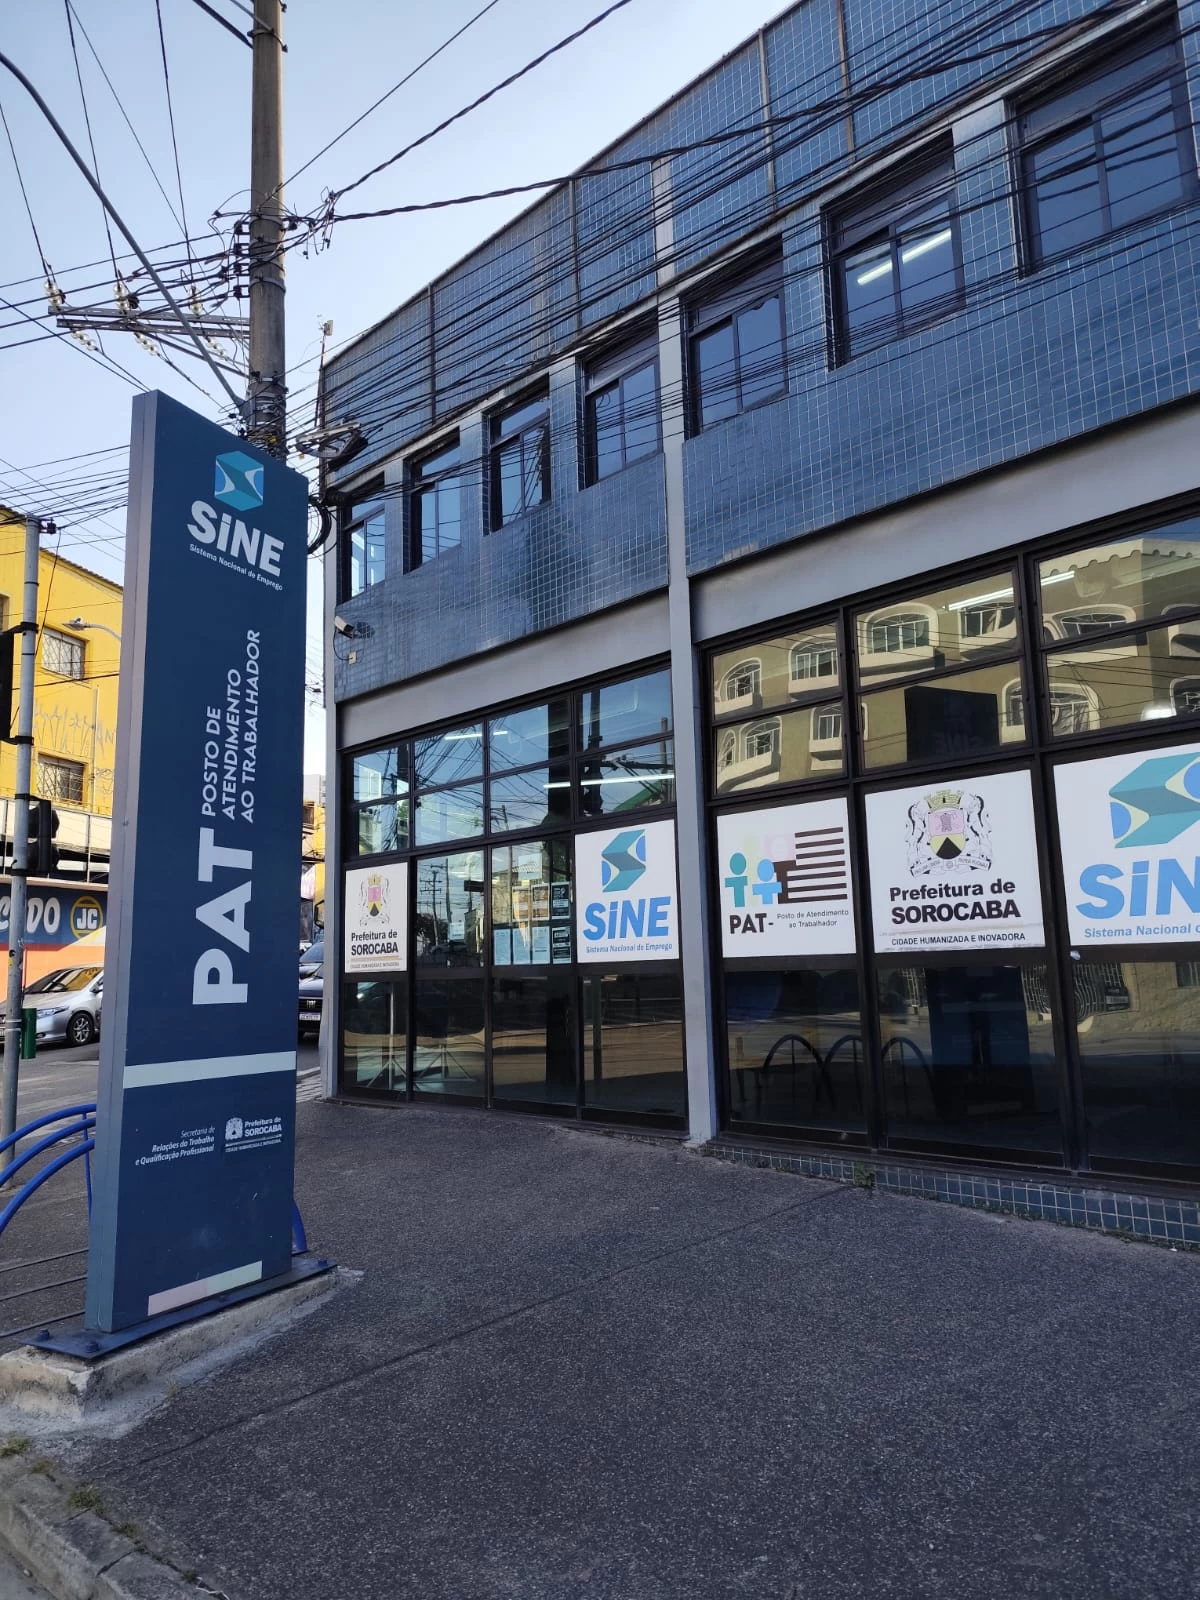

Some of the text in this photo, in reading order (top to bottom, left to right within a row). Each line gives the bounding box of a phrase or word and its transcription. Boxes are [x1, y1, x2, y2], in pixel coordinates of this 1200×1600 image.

[189, 543, 283, 591] Sistema Nacional de Emprego
[241, 629, 260, 823] AO TRABALHADOR
[222, 668, 241, 820] ATENDIMENTO
[202, 706, 221, 817] POSTO DE
[889, 878, 1016, 901] Prefeitura de
[76, 908, 98, 930] JC
[192, 827, 252, 1005] PAT
[806, 909, 849, 919] Atendimento
[891, 899, 1021, 925] SOROCABA
[799, 920, 838, 928] Trabalhador
[1084, 928, 1132, 938] Sistema
[1136, 923, 1191, 936] Nacional
[351, 929, 398, 942] Prefeitura de
[892, 932, 1026, 946] CIDADE HUMANIZADA E INOVADORA
[351, 942, 399, 956] SOROCABA
[586, 943, 672, 953] Sistema Nacional de Emprego
[180, 1125, 216, 1138] Secretaria de
[244, 1119, 273, 1128] Prefeitura
[244, 1123, 282, 1137] SOROCABA
[151, 1140, 179, 1153] Relações
[189, 1136, 214, 1146] Trabalho
[135, 1158, 140, 1166] e
[140, 1150, 179, 1165] Qualificação
[180, 1144, 214, 1157] Profissional
